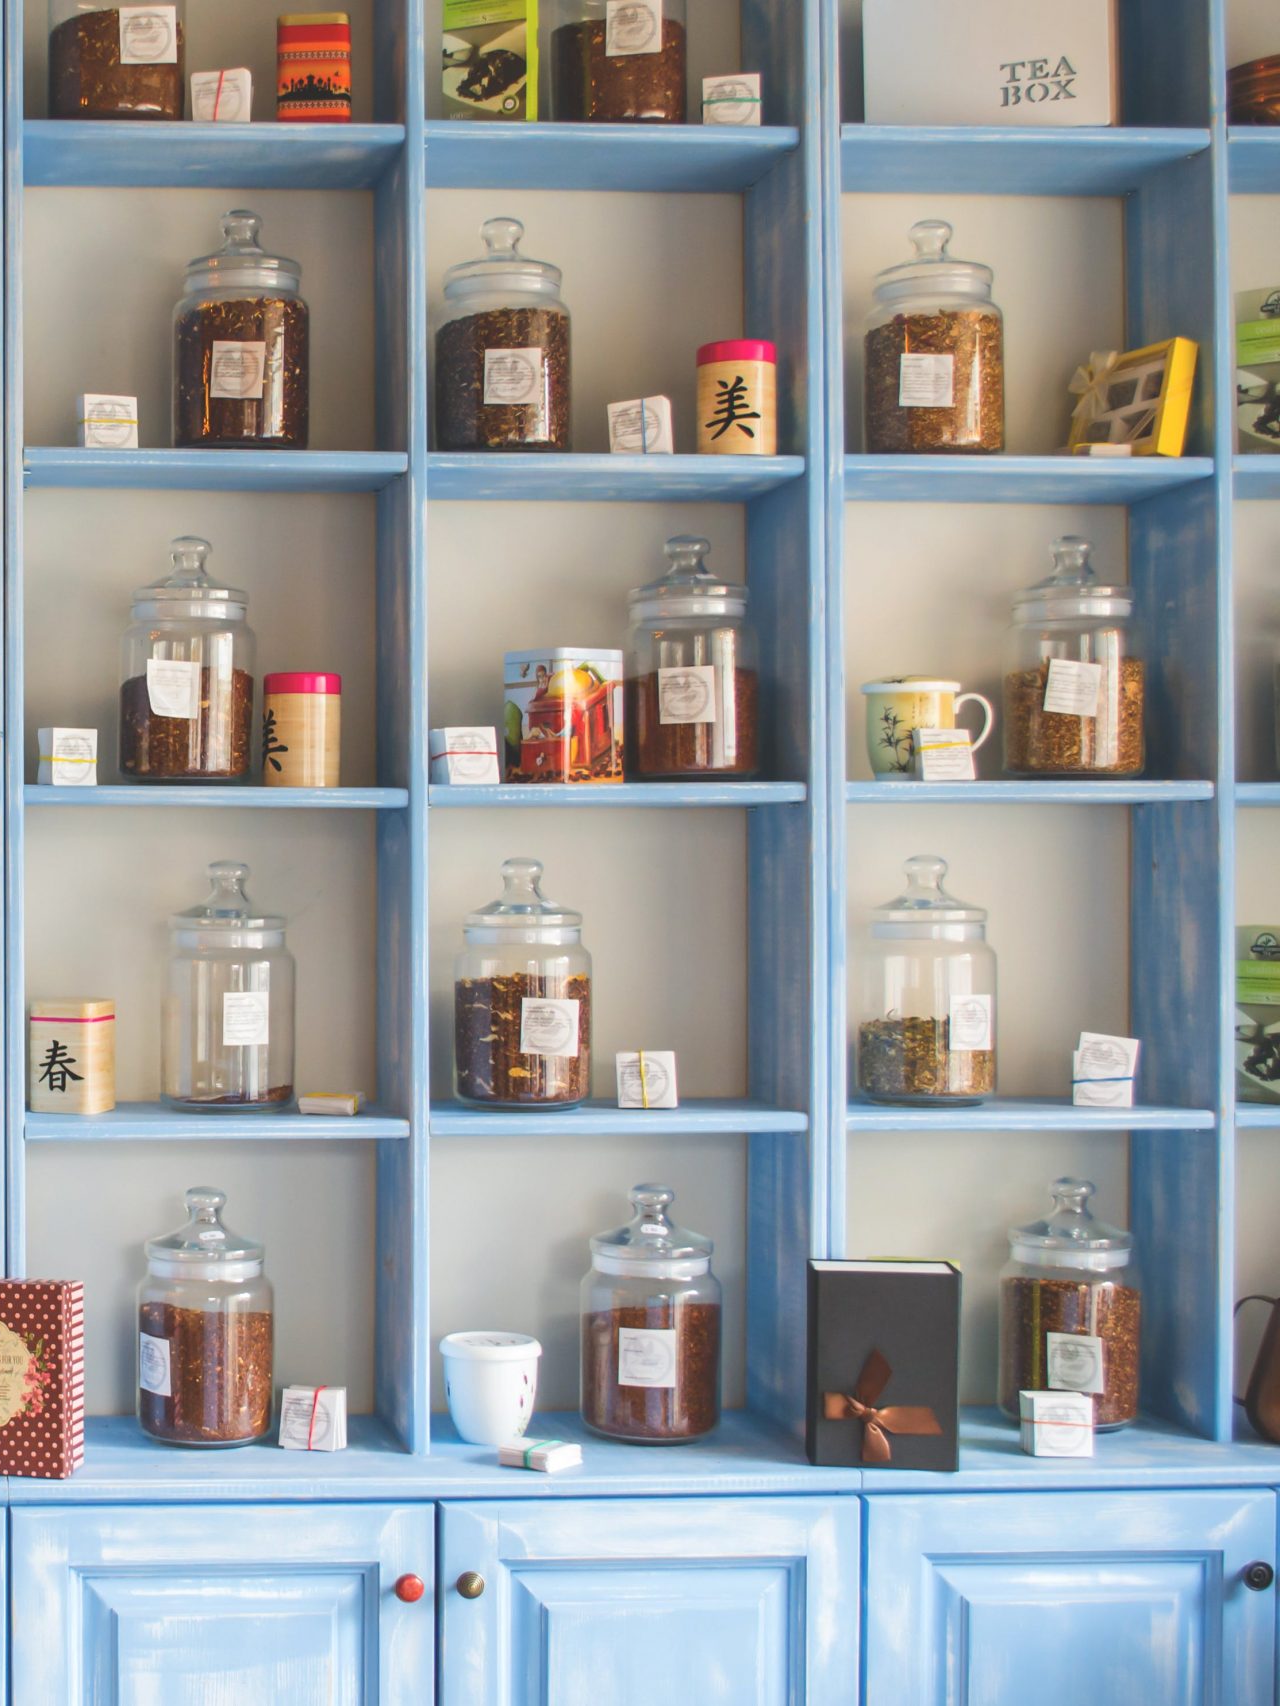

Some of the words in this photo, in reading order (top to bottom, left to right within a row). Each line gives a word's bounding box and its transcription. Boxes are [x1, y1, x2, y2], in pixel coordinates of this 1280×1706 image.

[1000, 56, 1077, 83] TEA
[1000, 78, 1077, 107] BOX
[705, 375, 761, 441] 美
[38, 1039, 85, 1093] 春
[1, 1355, 12, 1364] FOR
[12, 1356, 24, 1365] YOU
